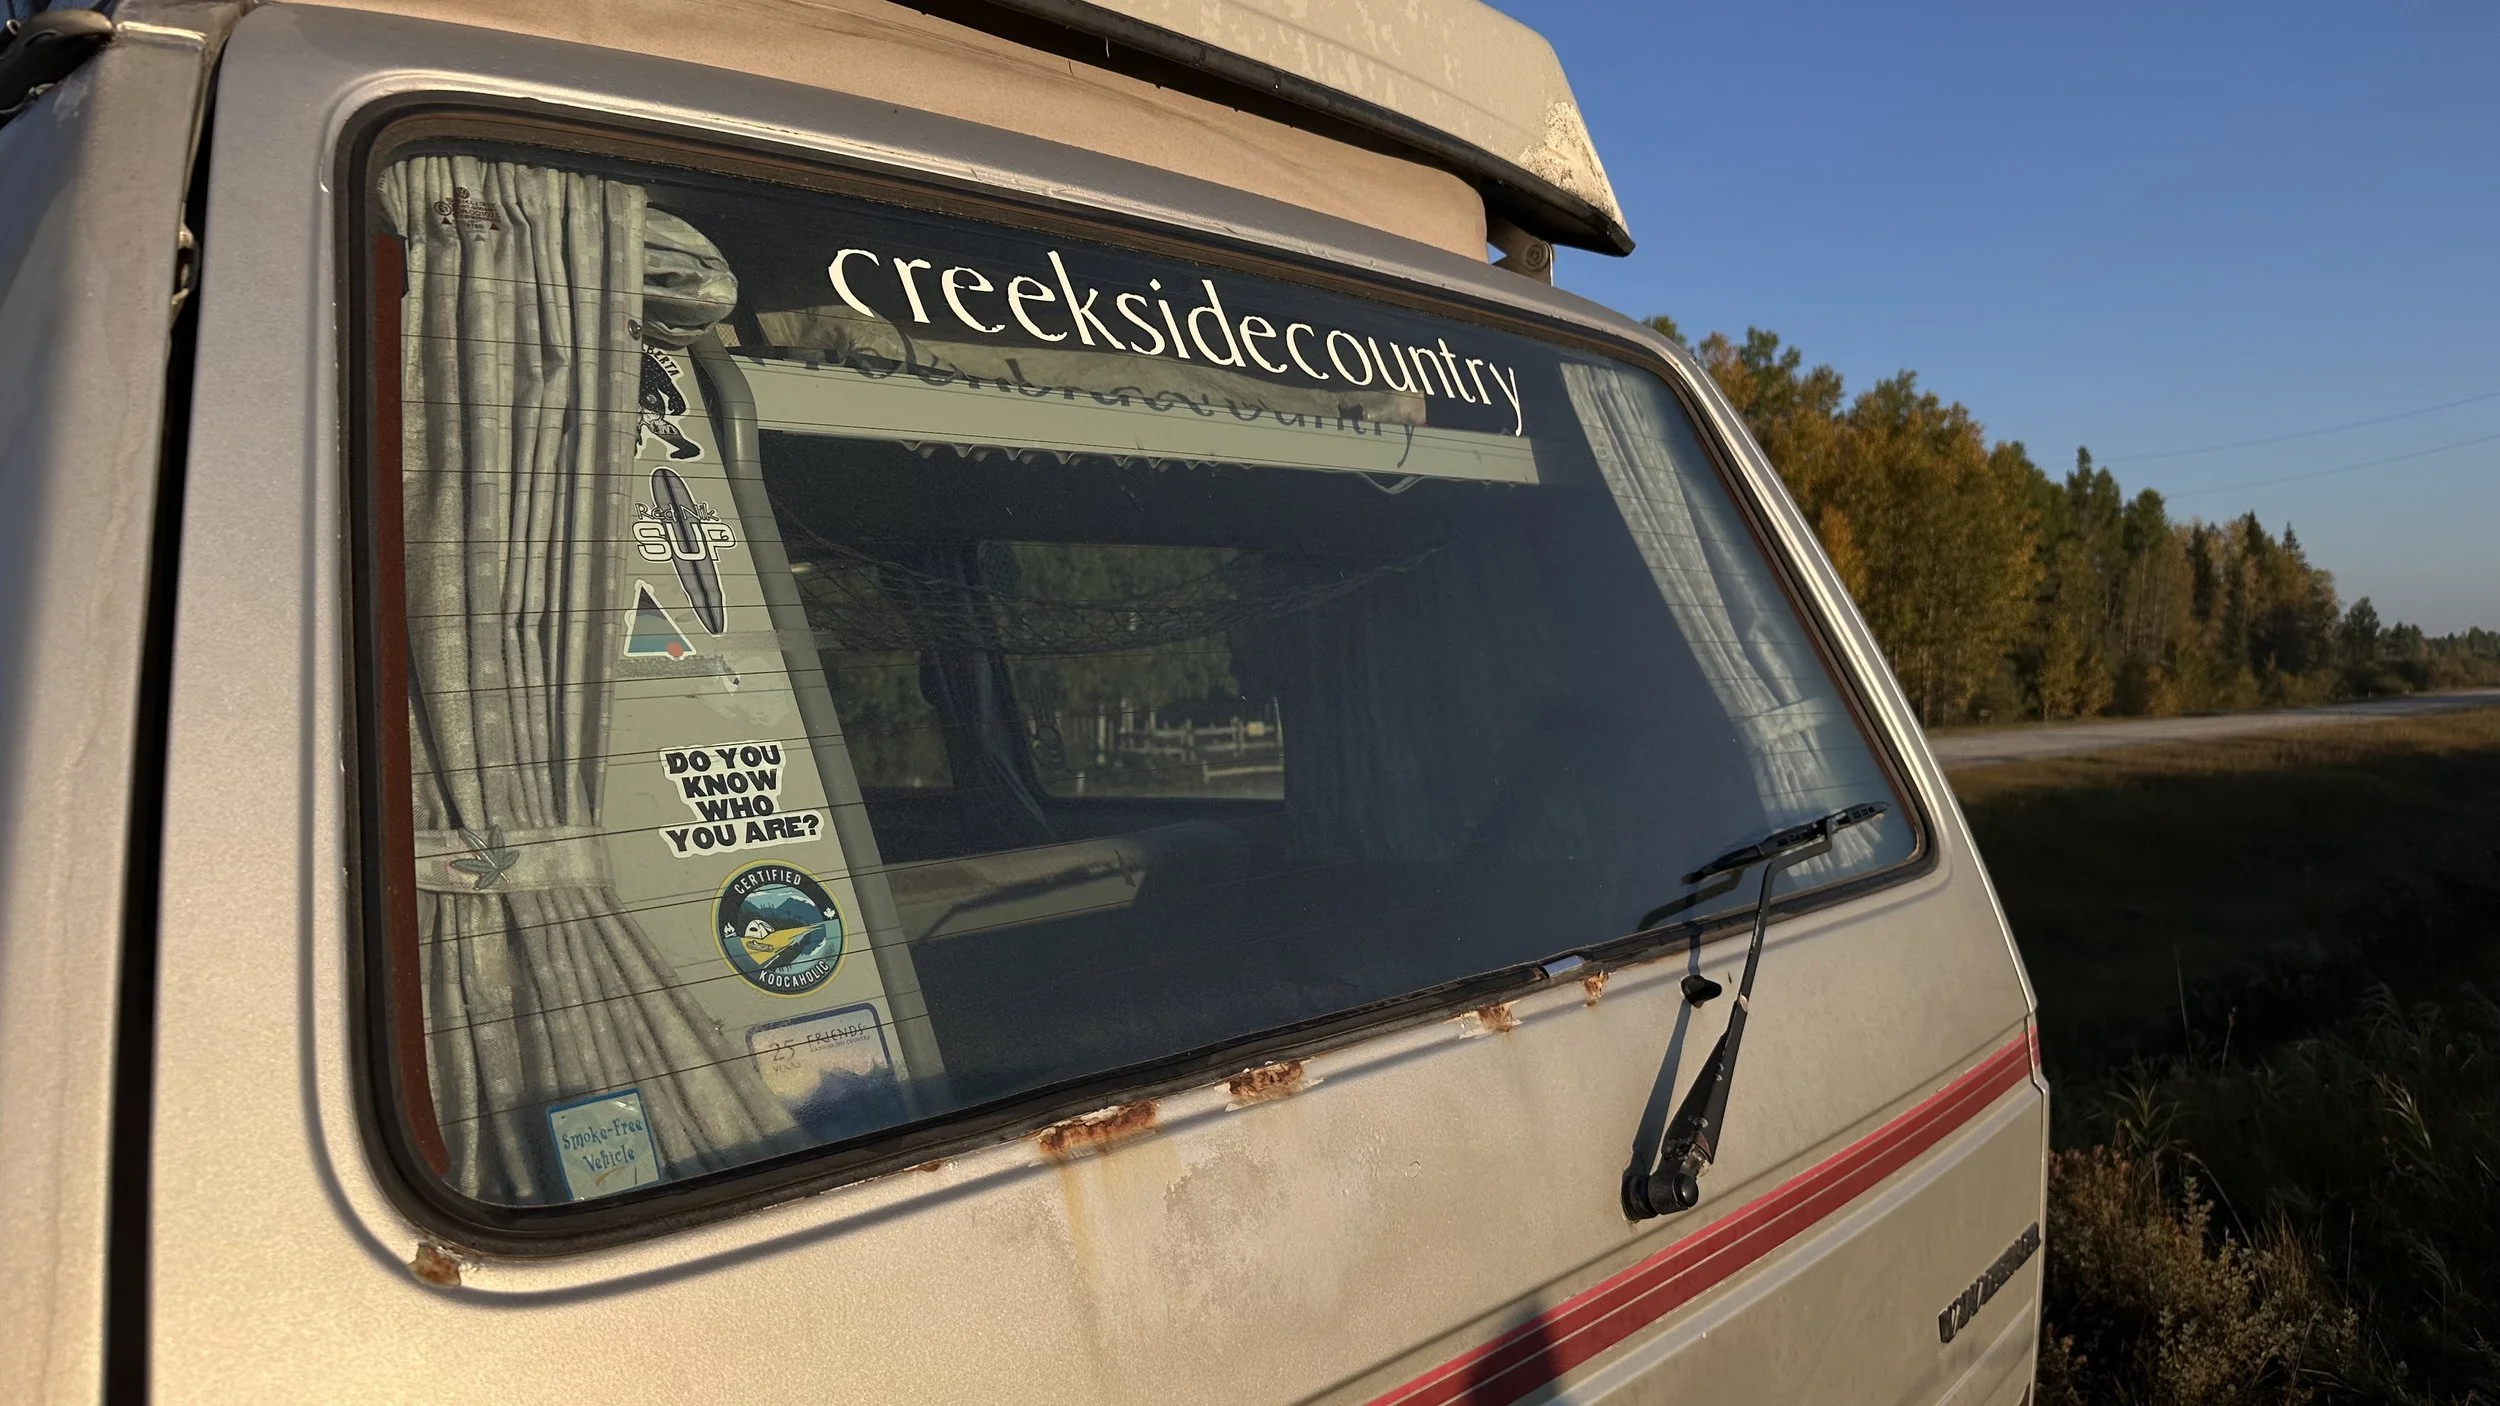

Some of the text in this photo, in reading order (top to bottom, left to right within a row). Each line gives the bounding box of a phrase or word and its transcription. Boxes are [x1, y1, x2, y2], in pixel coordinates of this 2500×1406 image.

[828, 247, 1523, 437] creeksidecountry
[635, 503, 719, 523] Red Nik
[632, 521, 736, 562] SUP
[665, 745, 781, 774] DO YOU
[681, 768, 778, 798] KNOW
[695, 794, 774, 822] WHO
[665, 814, 819, 852] YOU ARE?
[734, 869, 801, 895] CERTIFIED
[759, 960, 829, 987] KOOCAHOLIC
[806, 1022, 865, 1046] FRIENDS
[769, 1039, 796, 1062] 25
[562, 1117, 644, 1150] Smoke-Free
[582, 1145, 635, 1172] Vehicle
